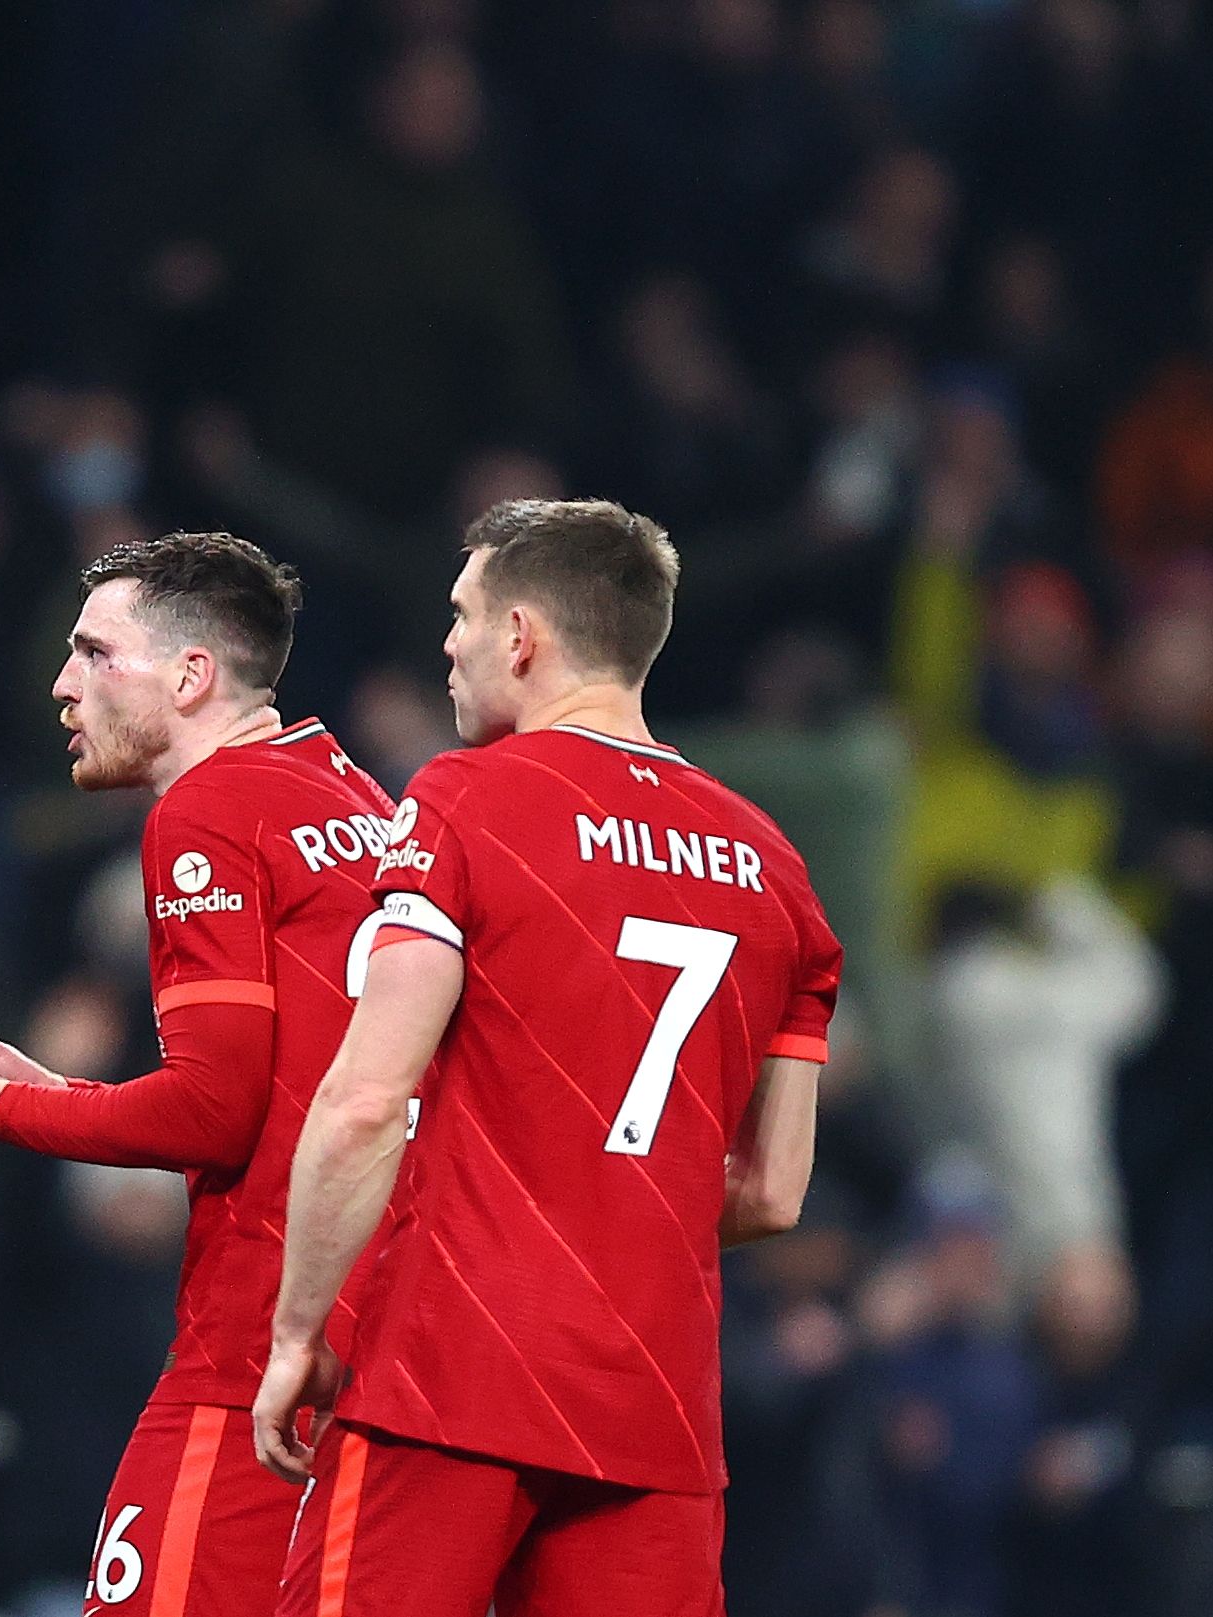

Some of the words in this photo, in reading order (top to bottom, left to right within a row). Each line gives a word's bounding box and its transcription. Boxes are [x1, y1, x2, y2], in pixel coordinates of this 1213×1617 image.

[575, 814, 764, 893] MILNER
[156, 887, 243, 922] Expedia
[603, 915, 739, 1157] 7
[85, 1504, 143, 1604] 6
